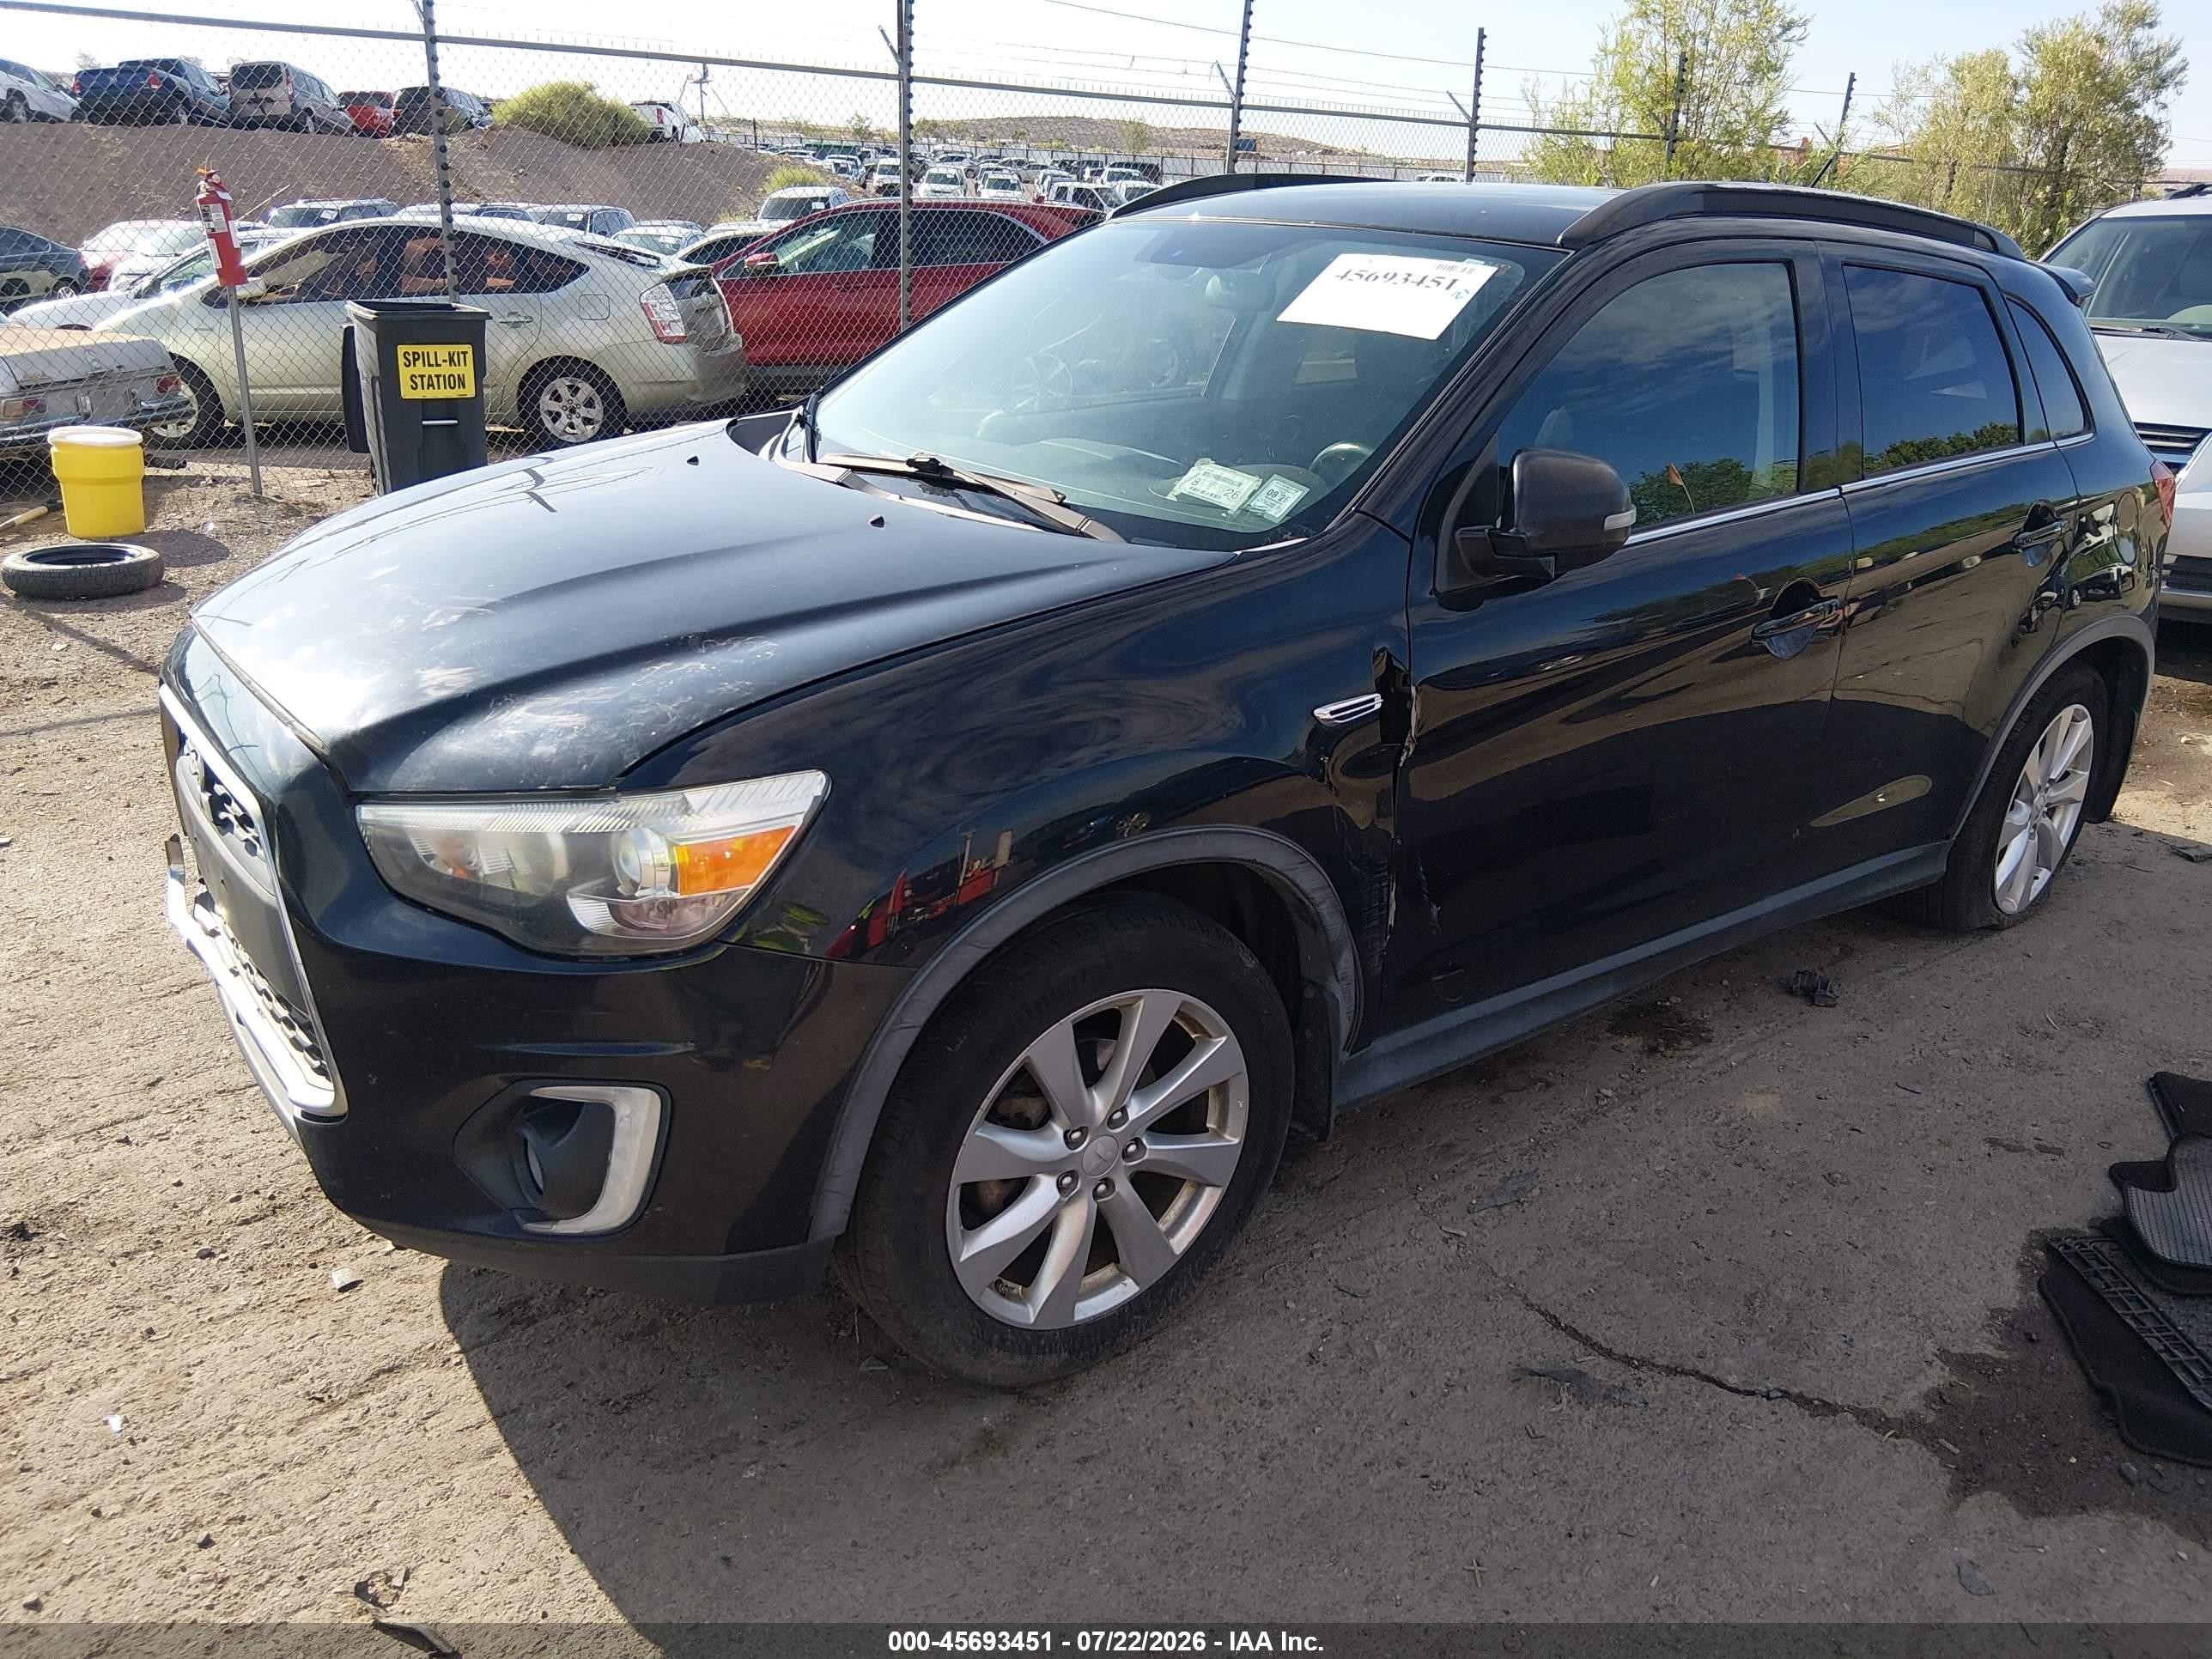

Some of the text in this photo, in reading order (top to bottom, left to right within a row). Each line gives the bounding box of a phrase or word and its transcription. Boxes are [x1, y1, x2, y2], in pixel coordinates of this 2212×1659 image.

[1335, 269, 1459, 290] 45693451
[403, 350, 469, 368] SPILL-KIT
[410, 374, 466, 391] STATION
[1191, 477, 1201, 486] 8
[1224, 488, 1242, 500] 26
